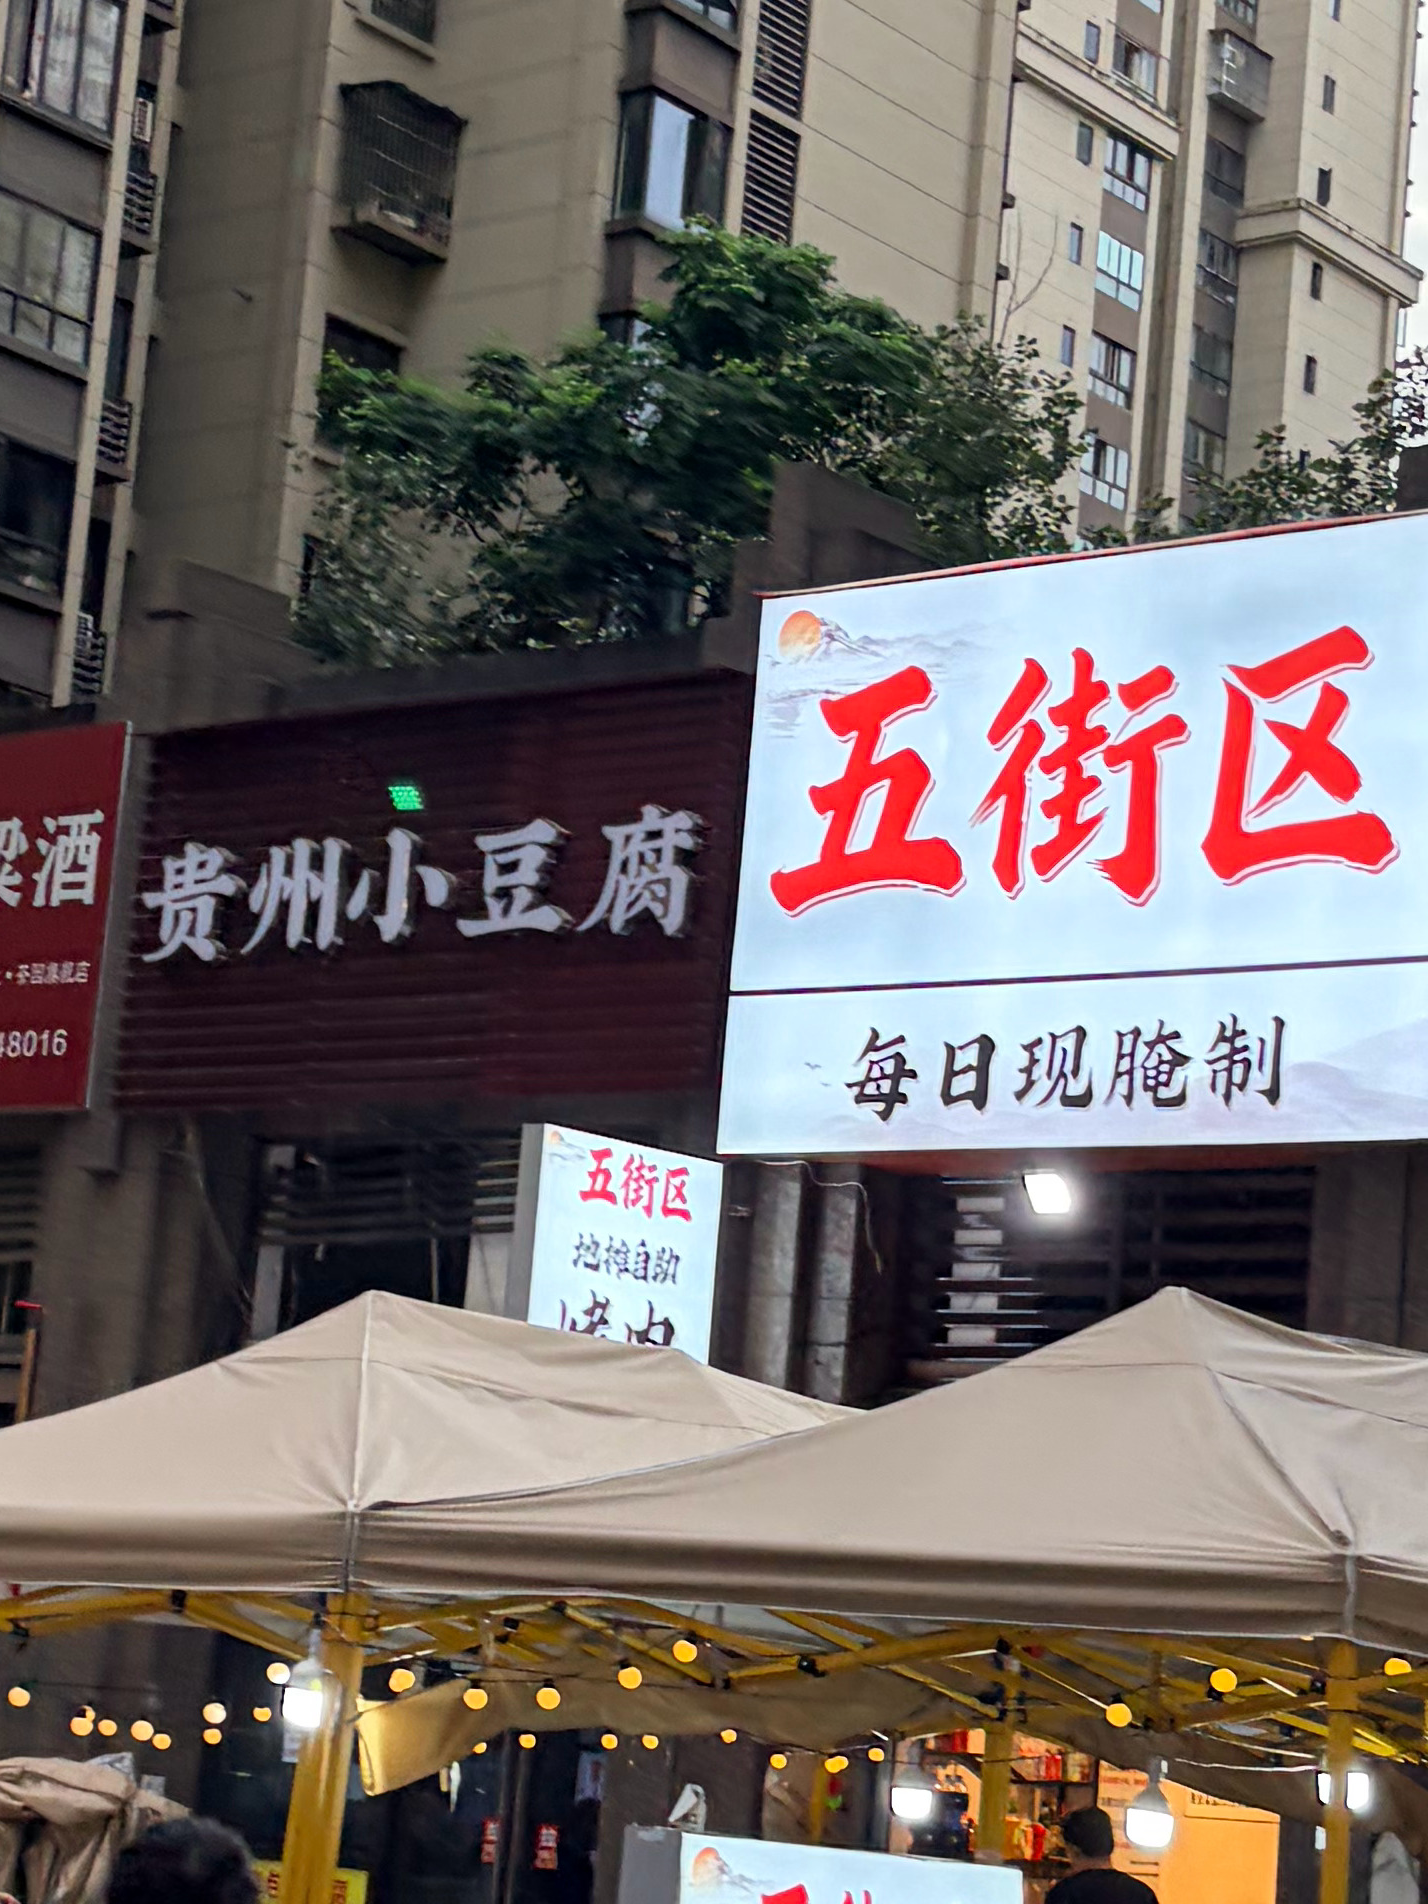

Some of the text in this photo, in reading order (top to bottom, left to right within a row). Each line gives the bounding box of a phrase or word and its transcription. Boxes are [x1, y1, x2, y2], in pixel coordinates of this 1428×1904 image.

[769, 625, 1401, 918] 五街区
[141, 804, 707, 963] 贵州小豆腐
[844, 1013, 1287, 1123] 每日现腌制
[578, 1147, 692, 1222] 五街区
[571, 1232, 681, 1284] 地摊自助
